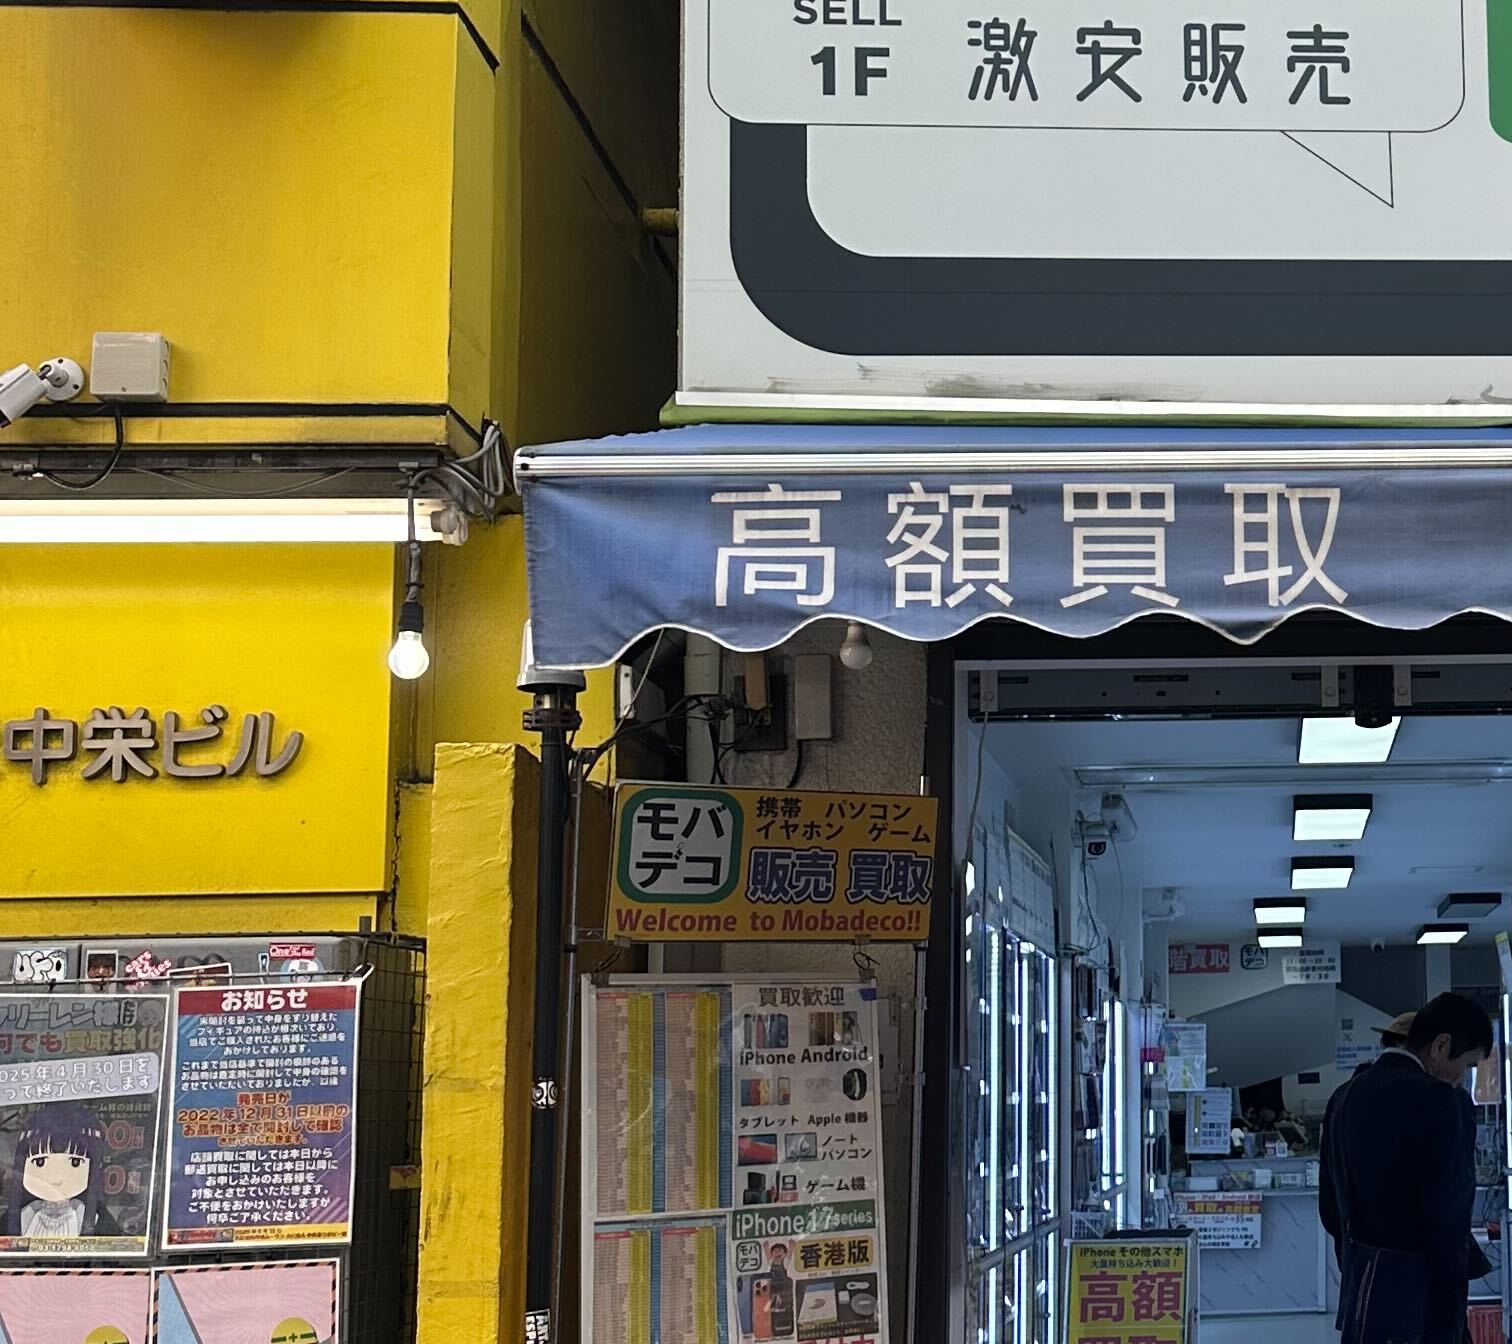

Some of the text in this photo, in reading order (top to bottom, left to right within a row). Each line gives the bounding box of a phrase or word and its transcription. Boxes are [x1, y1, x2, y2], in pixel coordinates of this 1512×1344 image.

[809, 16, 1354, 108] 1F 激安販売
[710, 480, 1350, 612] 高額買取
[3, 703, 306, 787] 中栄ビル
[636, 801, 729, 842] モバ
[756, 795, 912, 822] 携帯 パソコン
[756, 819, 931, 844] イヤホン ゲーム
[635, 849, 722, 888] デコ
[746, 846, 933, 905] 販売 買取
[615, 907, 922, 933] Welcome to Mobadeco!!
[221, 989, 309, 1011] お知らせ
[758, 985, 846, 1008] 買取歓迎
[739, 1045, 869, 1066] iPhone Android
[738, 1114, 800, 1130] タブレット
[807, 1112, 842, 1128] Apple
[821, 1133, 859, 1147] ノート
[805, 1176, 867, 1195] ゲーム機
[735, 1213, 805, 1239] iPhone
[799, 1238, 871, 1270] 香港版
[1079, 1246, 1117, 1258] iPhone
[1079, 1269, 1184, 1323] 高額
